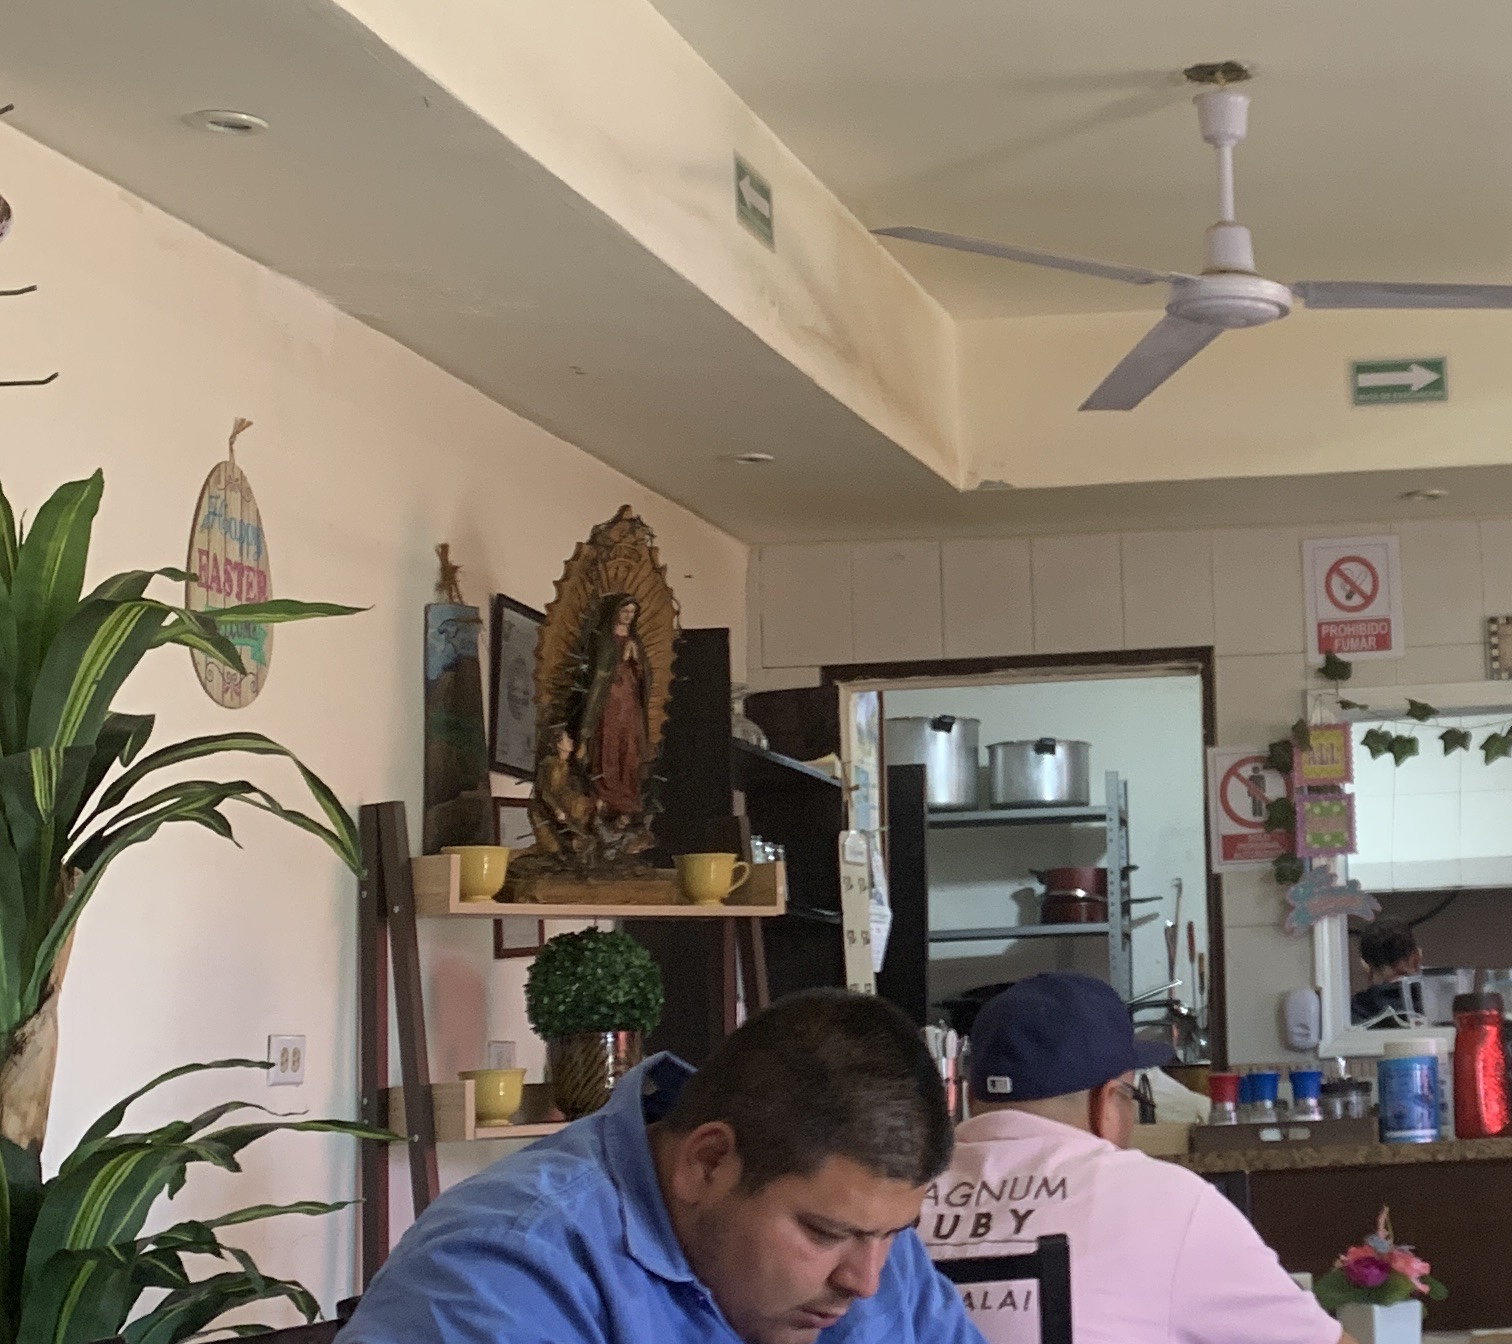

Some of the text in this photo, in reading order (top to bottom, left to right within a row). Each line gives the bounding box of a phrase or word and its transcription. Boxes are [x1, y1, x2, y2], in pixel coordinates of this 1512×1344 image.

[197, 547, 267, 603] EASTER
[1321, 621, 1388, 638] PROHIBIDO
[1334, 637, 1377, 653] FUMAR
[924, 1175, 1067, 1207] AGNUM
